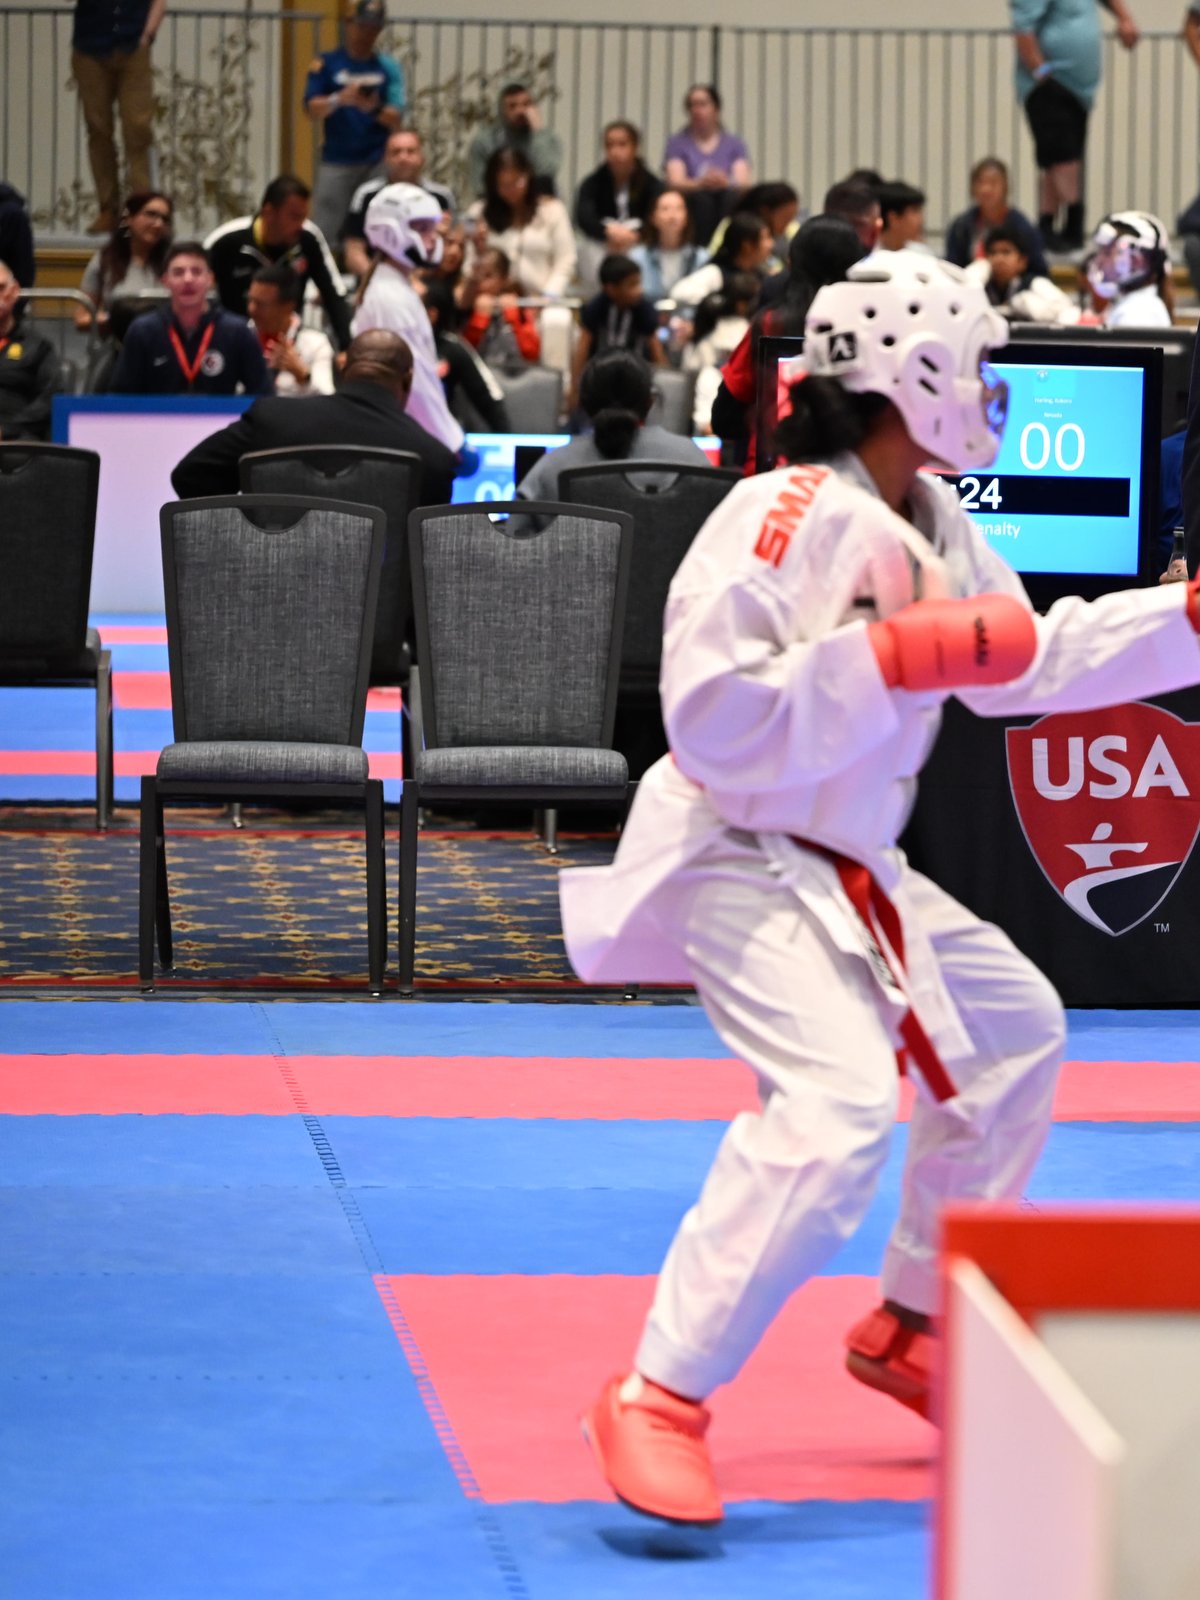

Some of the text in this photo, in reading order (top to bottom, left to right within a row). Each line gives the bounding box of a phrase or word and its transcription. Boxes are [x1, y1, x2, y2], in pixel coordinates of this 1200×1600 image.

[1019, 422, 1085, 471] 00
[976, 521, 1021, 539] enalty
[1031, 734, 1191, 801] USA
[1154, 923, 1170, 933] TM
